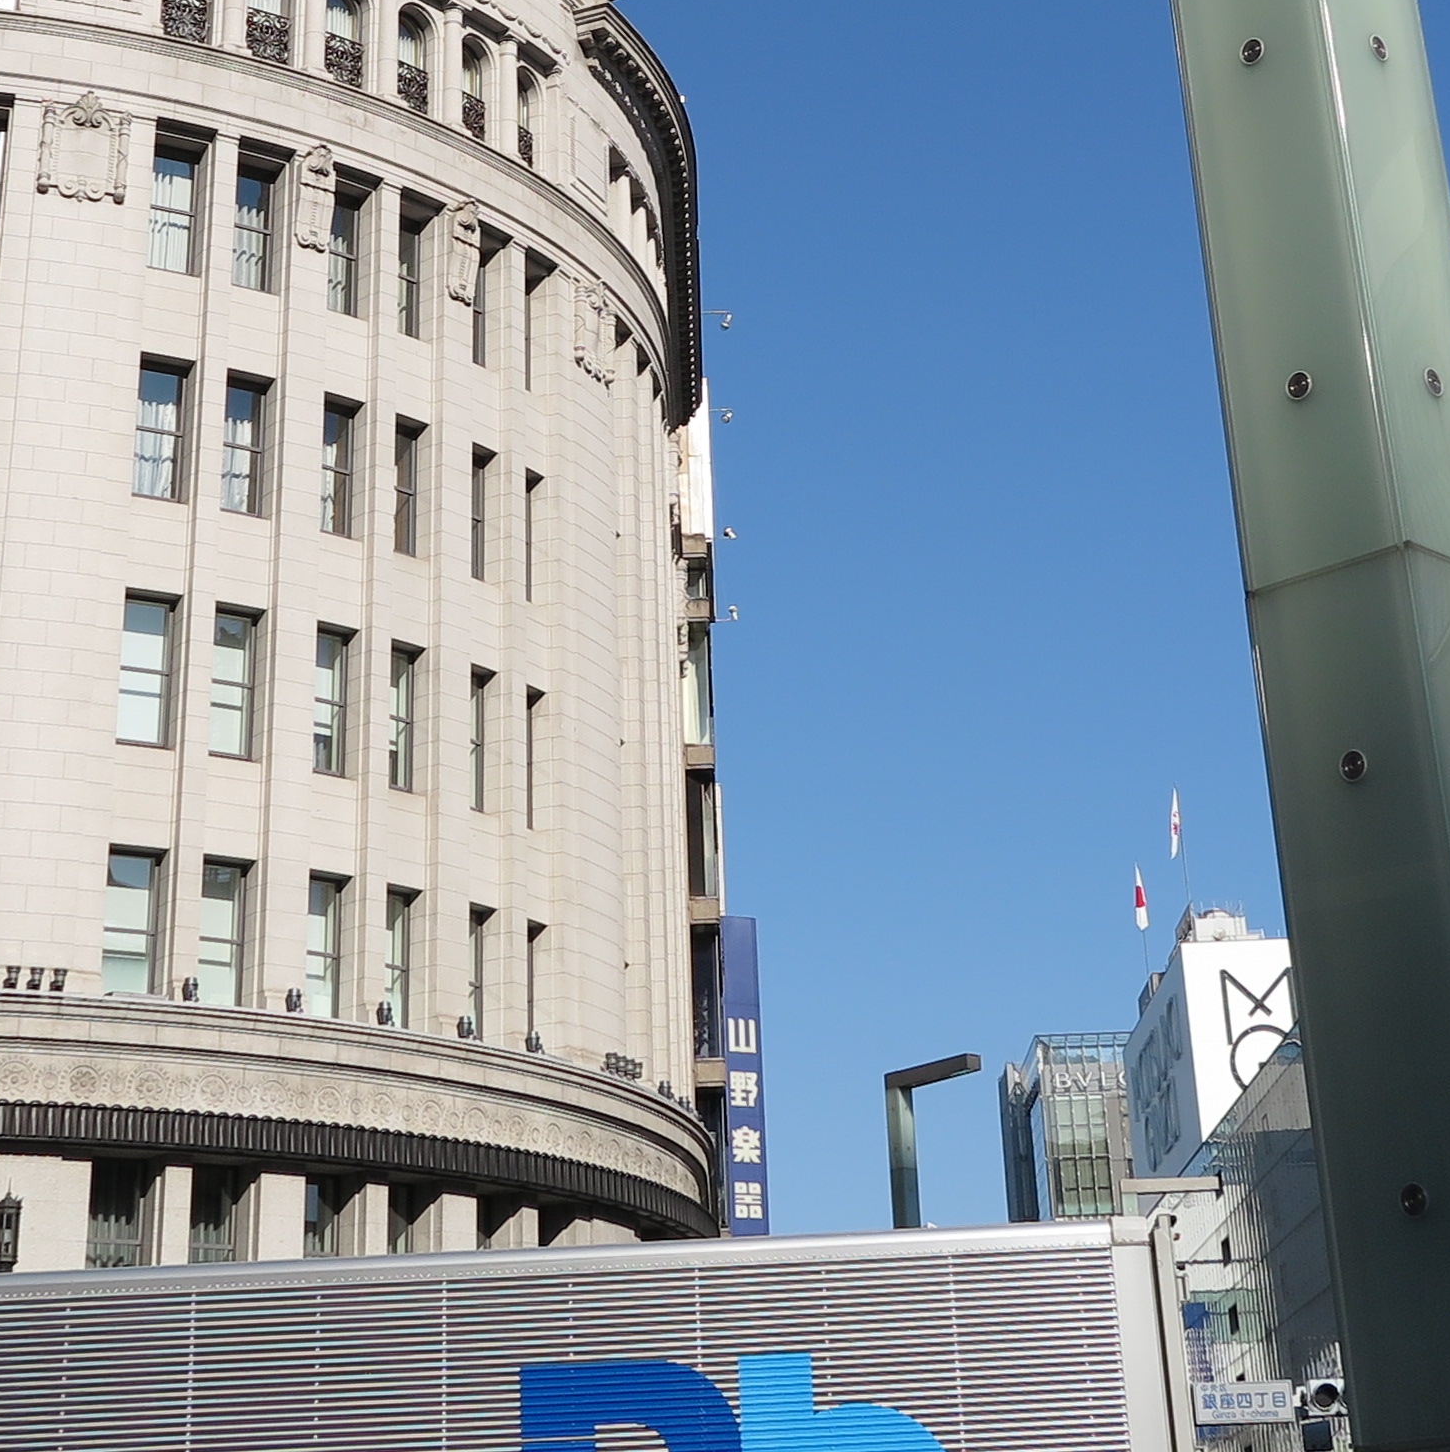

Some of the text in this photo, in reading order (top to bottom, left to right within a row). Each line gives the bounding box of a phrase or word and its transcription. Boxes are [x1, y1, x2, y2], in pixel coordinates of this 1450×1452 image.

[727, 1017, 764, 1220] 山野楽器
[1202, 1391, 1287, 1410] 銀座四丁目
